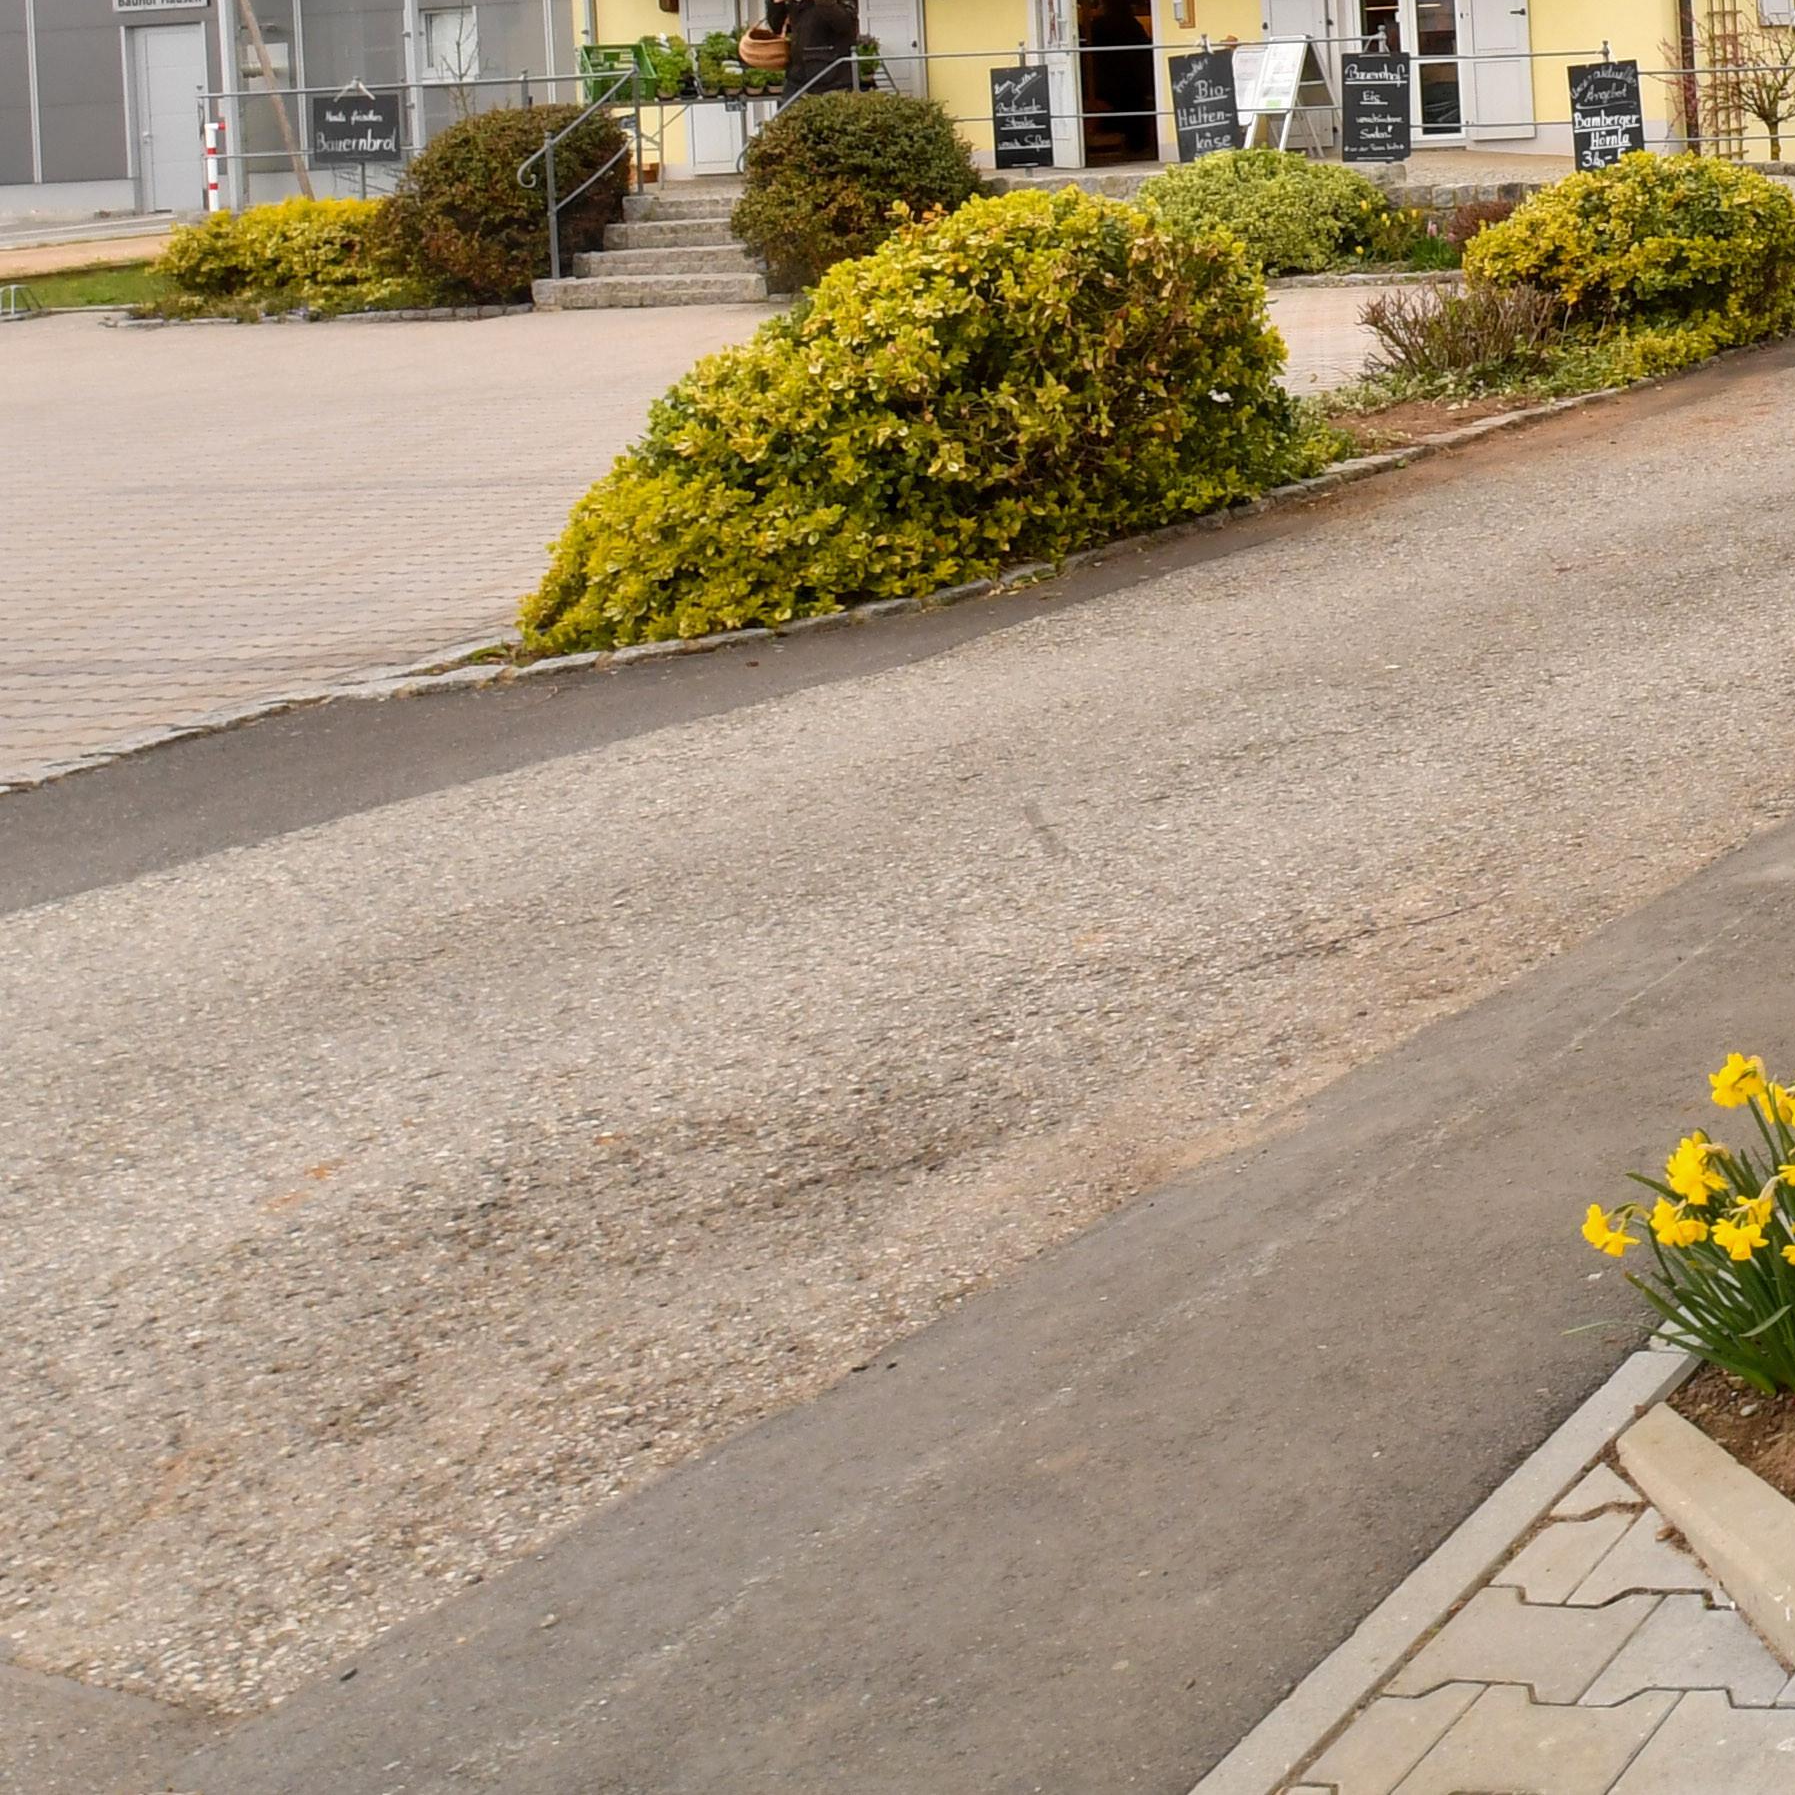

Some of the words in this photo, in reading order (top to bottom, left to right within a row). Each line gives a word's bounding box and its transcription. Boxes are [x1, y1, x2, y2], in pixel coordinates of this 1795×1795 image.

[1194, 79, 1232, 99] Bio-
[1362, 90, 1381, 102] Eis
[1574, 109, 1641, 131] Bamberger
[316, 127, 396, 153] Bauernbrot
[1590, 128, 1631, 148] Hörnla
